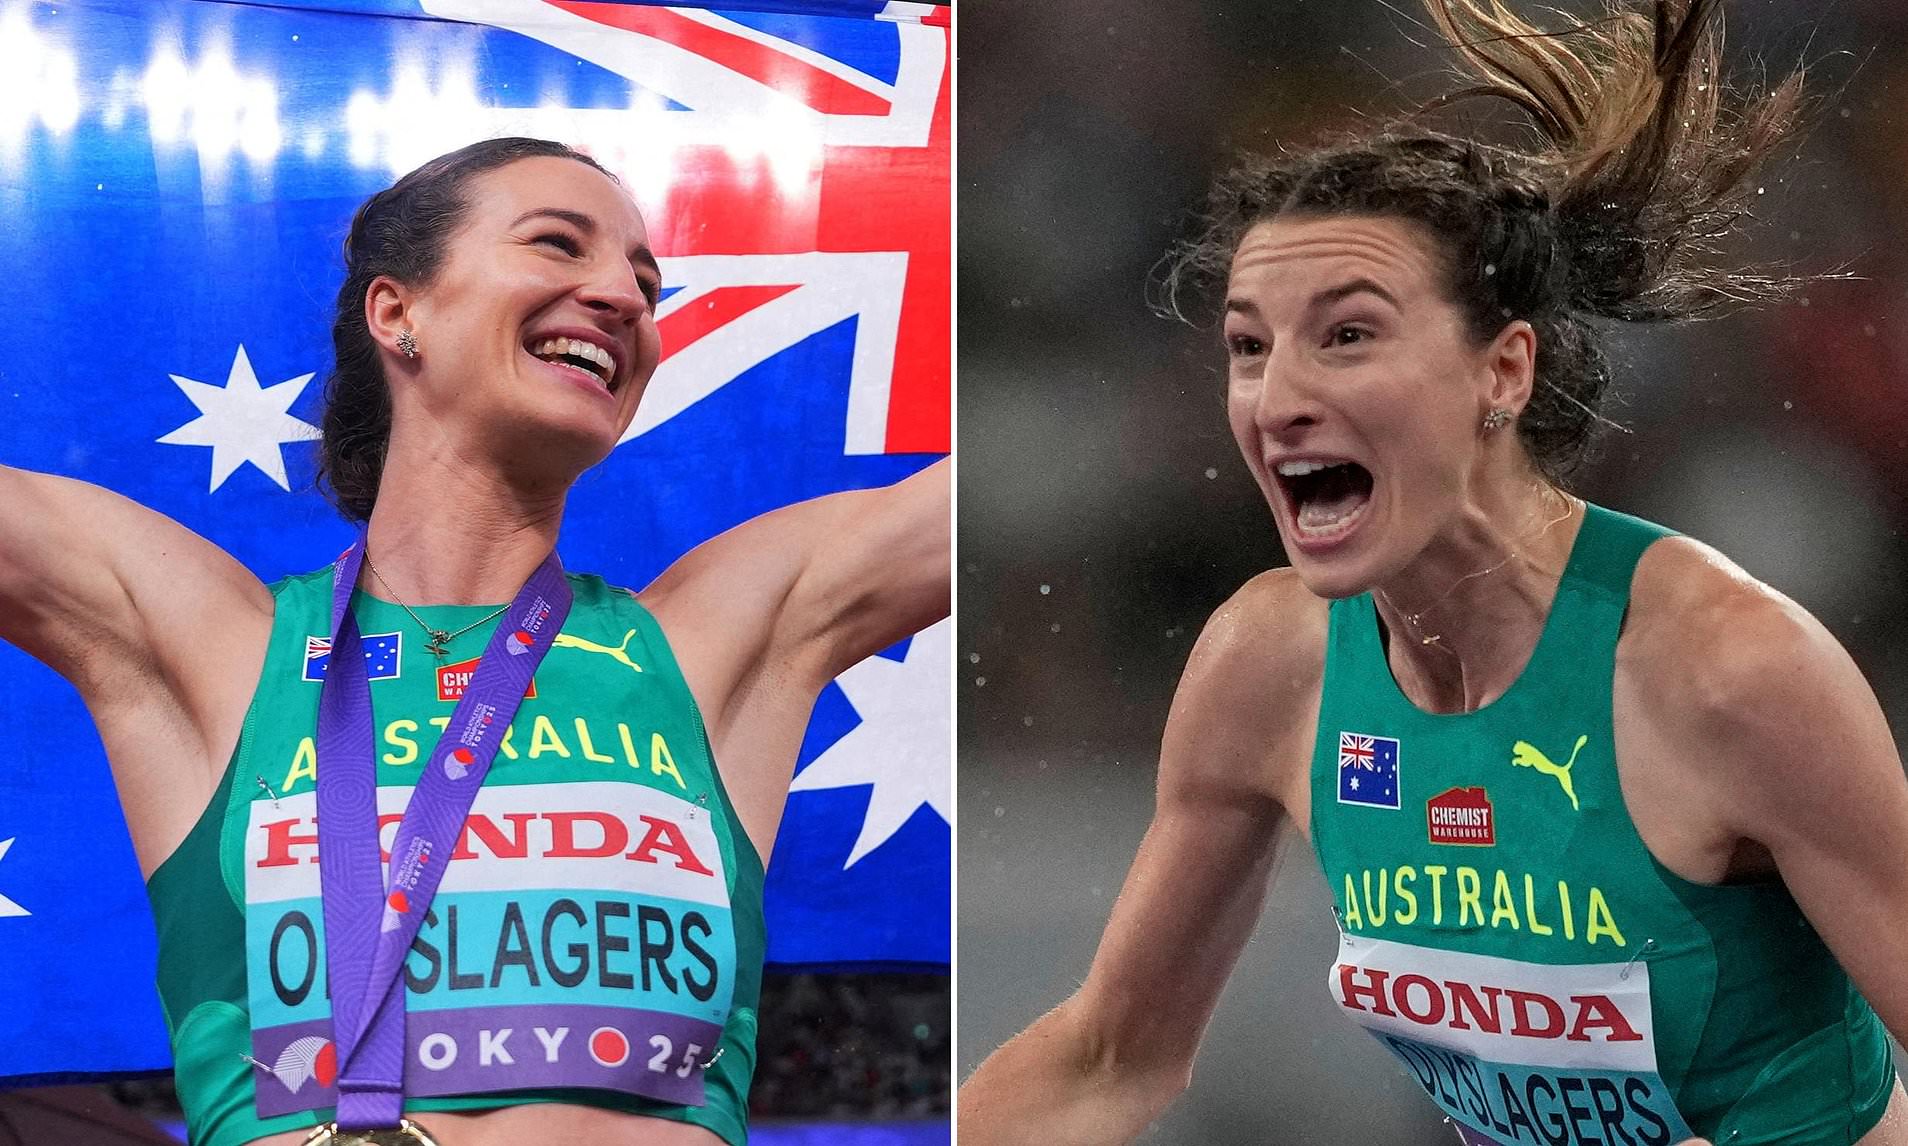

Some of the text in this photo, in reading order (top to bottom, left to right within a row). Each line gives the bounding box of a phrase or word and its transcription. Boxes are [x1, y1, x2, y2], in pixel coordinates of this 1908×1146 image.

[1431, 806, 1488, 826] CHEMIST
[1432, 827, 1489, 838] WAREHOUSE
[1345, 865, 1626, 947] AUSTRALIA
[269, 899, 718, 1006] OSLAGERS
[1337, 964, 1643, 1042] HONDA
[648, 1034, 702, 1078] 25
[1386, 1036, 1671, 1146] OLYSLAGERS
